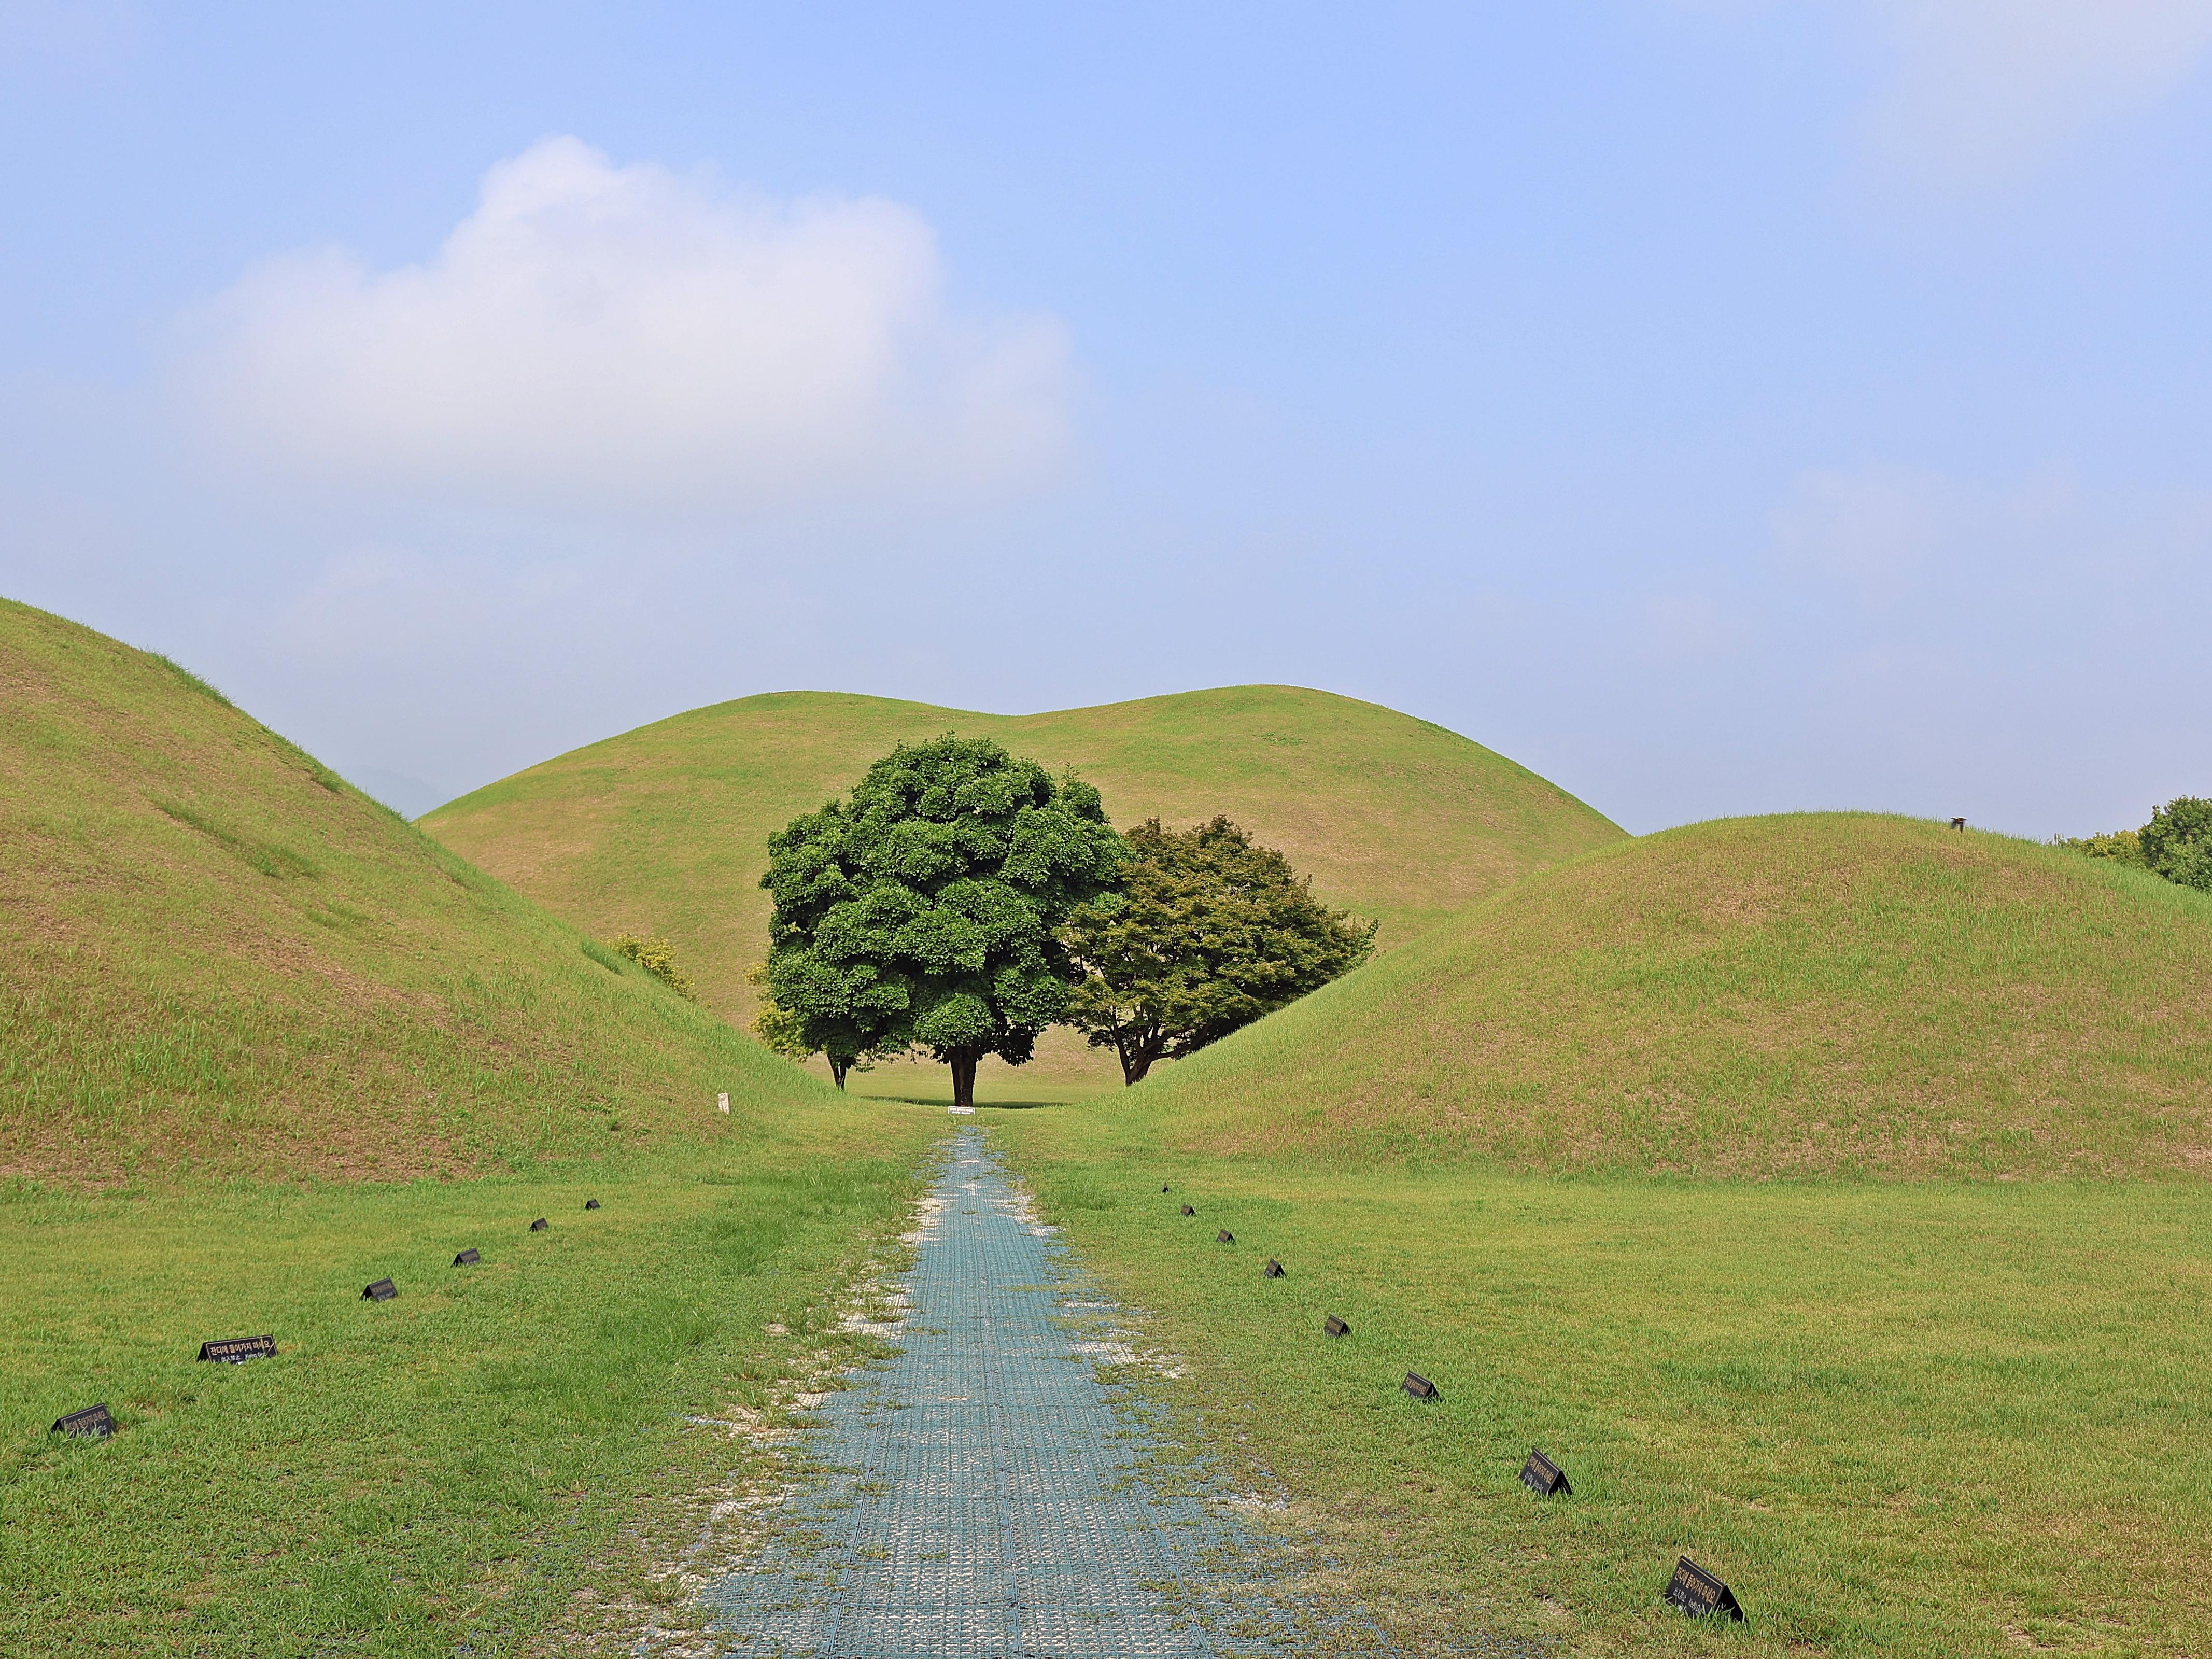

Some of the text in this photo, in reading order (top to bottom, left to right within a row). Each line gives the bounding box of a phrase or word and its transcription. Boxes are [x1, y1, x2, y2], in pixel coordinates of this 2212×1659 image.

[210, 1344, 229, 1356] 잔디에
[229, 1342, 252, 1353] 들어가지
[1674, 1566, 1716, 1605] 잔디에 들어가지 마세요
